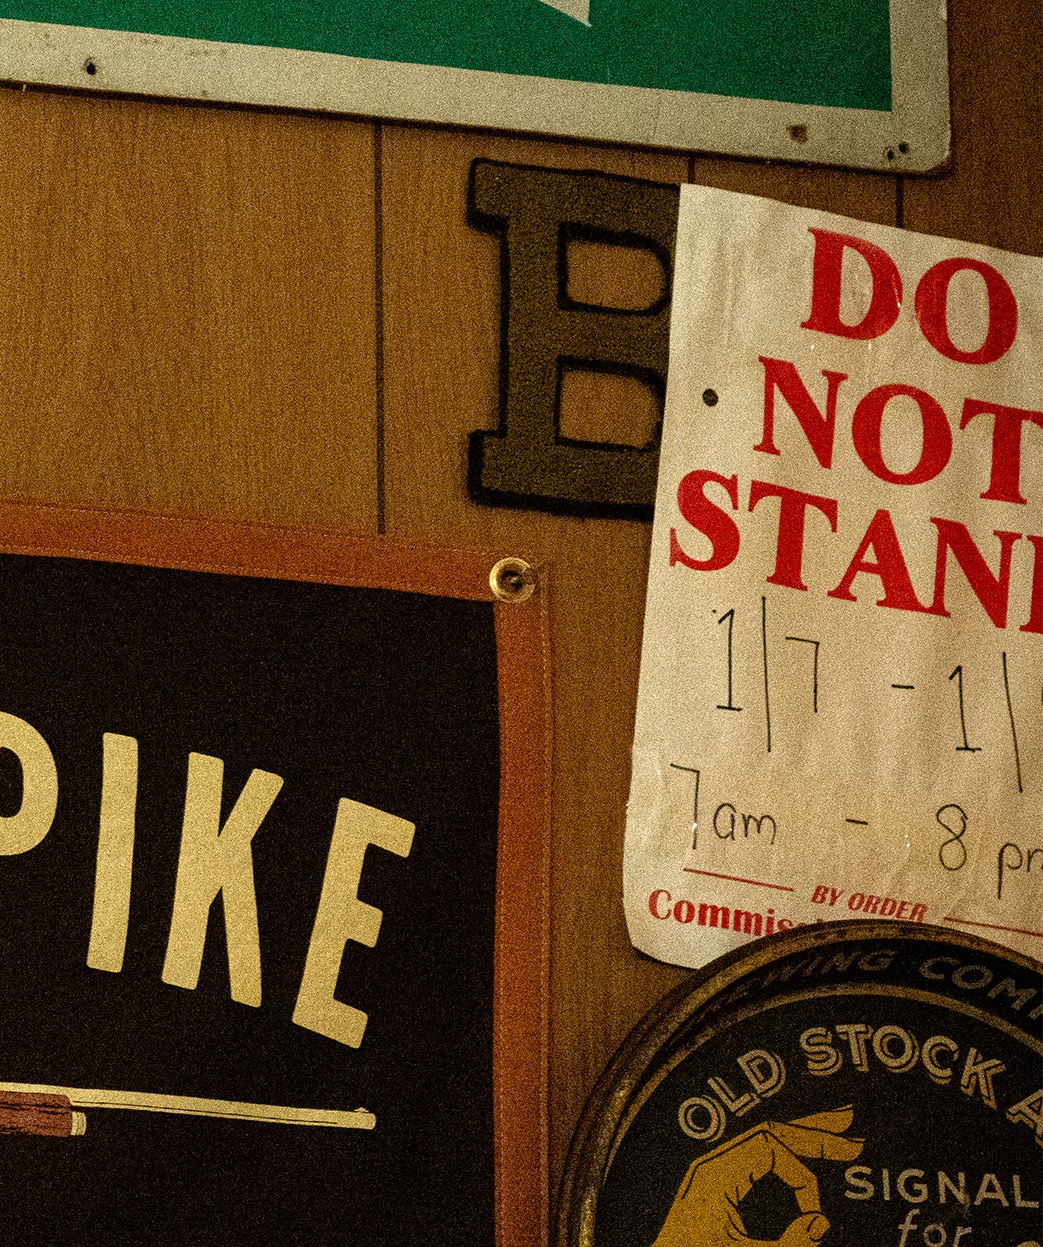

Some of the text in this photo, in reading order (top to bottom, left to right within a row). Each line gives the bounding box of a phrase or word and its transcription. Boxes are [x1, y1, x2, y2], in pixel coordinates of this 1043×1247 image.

[800, 227, 1018, 365] DO
[753, 355, 1043, 505] NOT
[669, 469, 1043, 634] STAN
[810, 885, 929, 923] BY ORDER
[919, 955, 1043, 1020] COM
[677, 1049, 788, 1141] OLD
[799, 1023, 1008, 1111] STOCK
[844, 1164, 1040, 1209] SIGNAL
